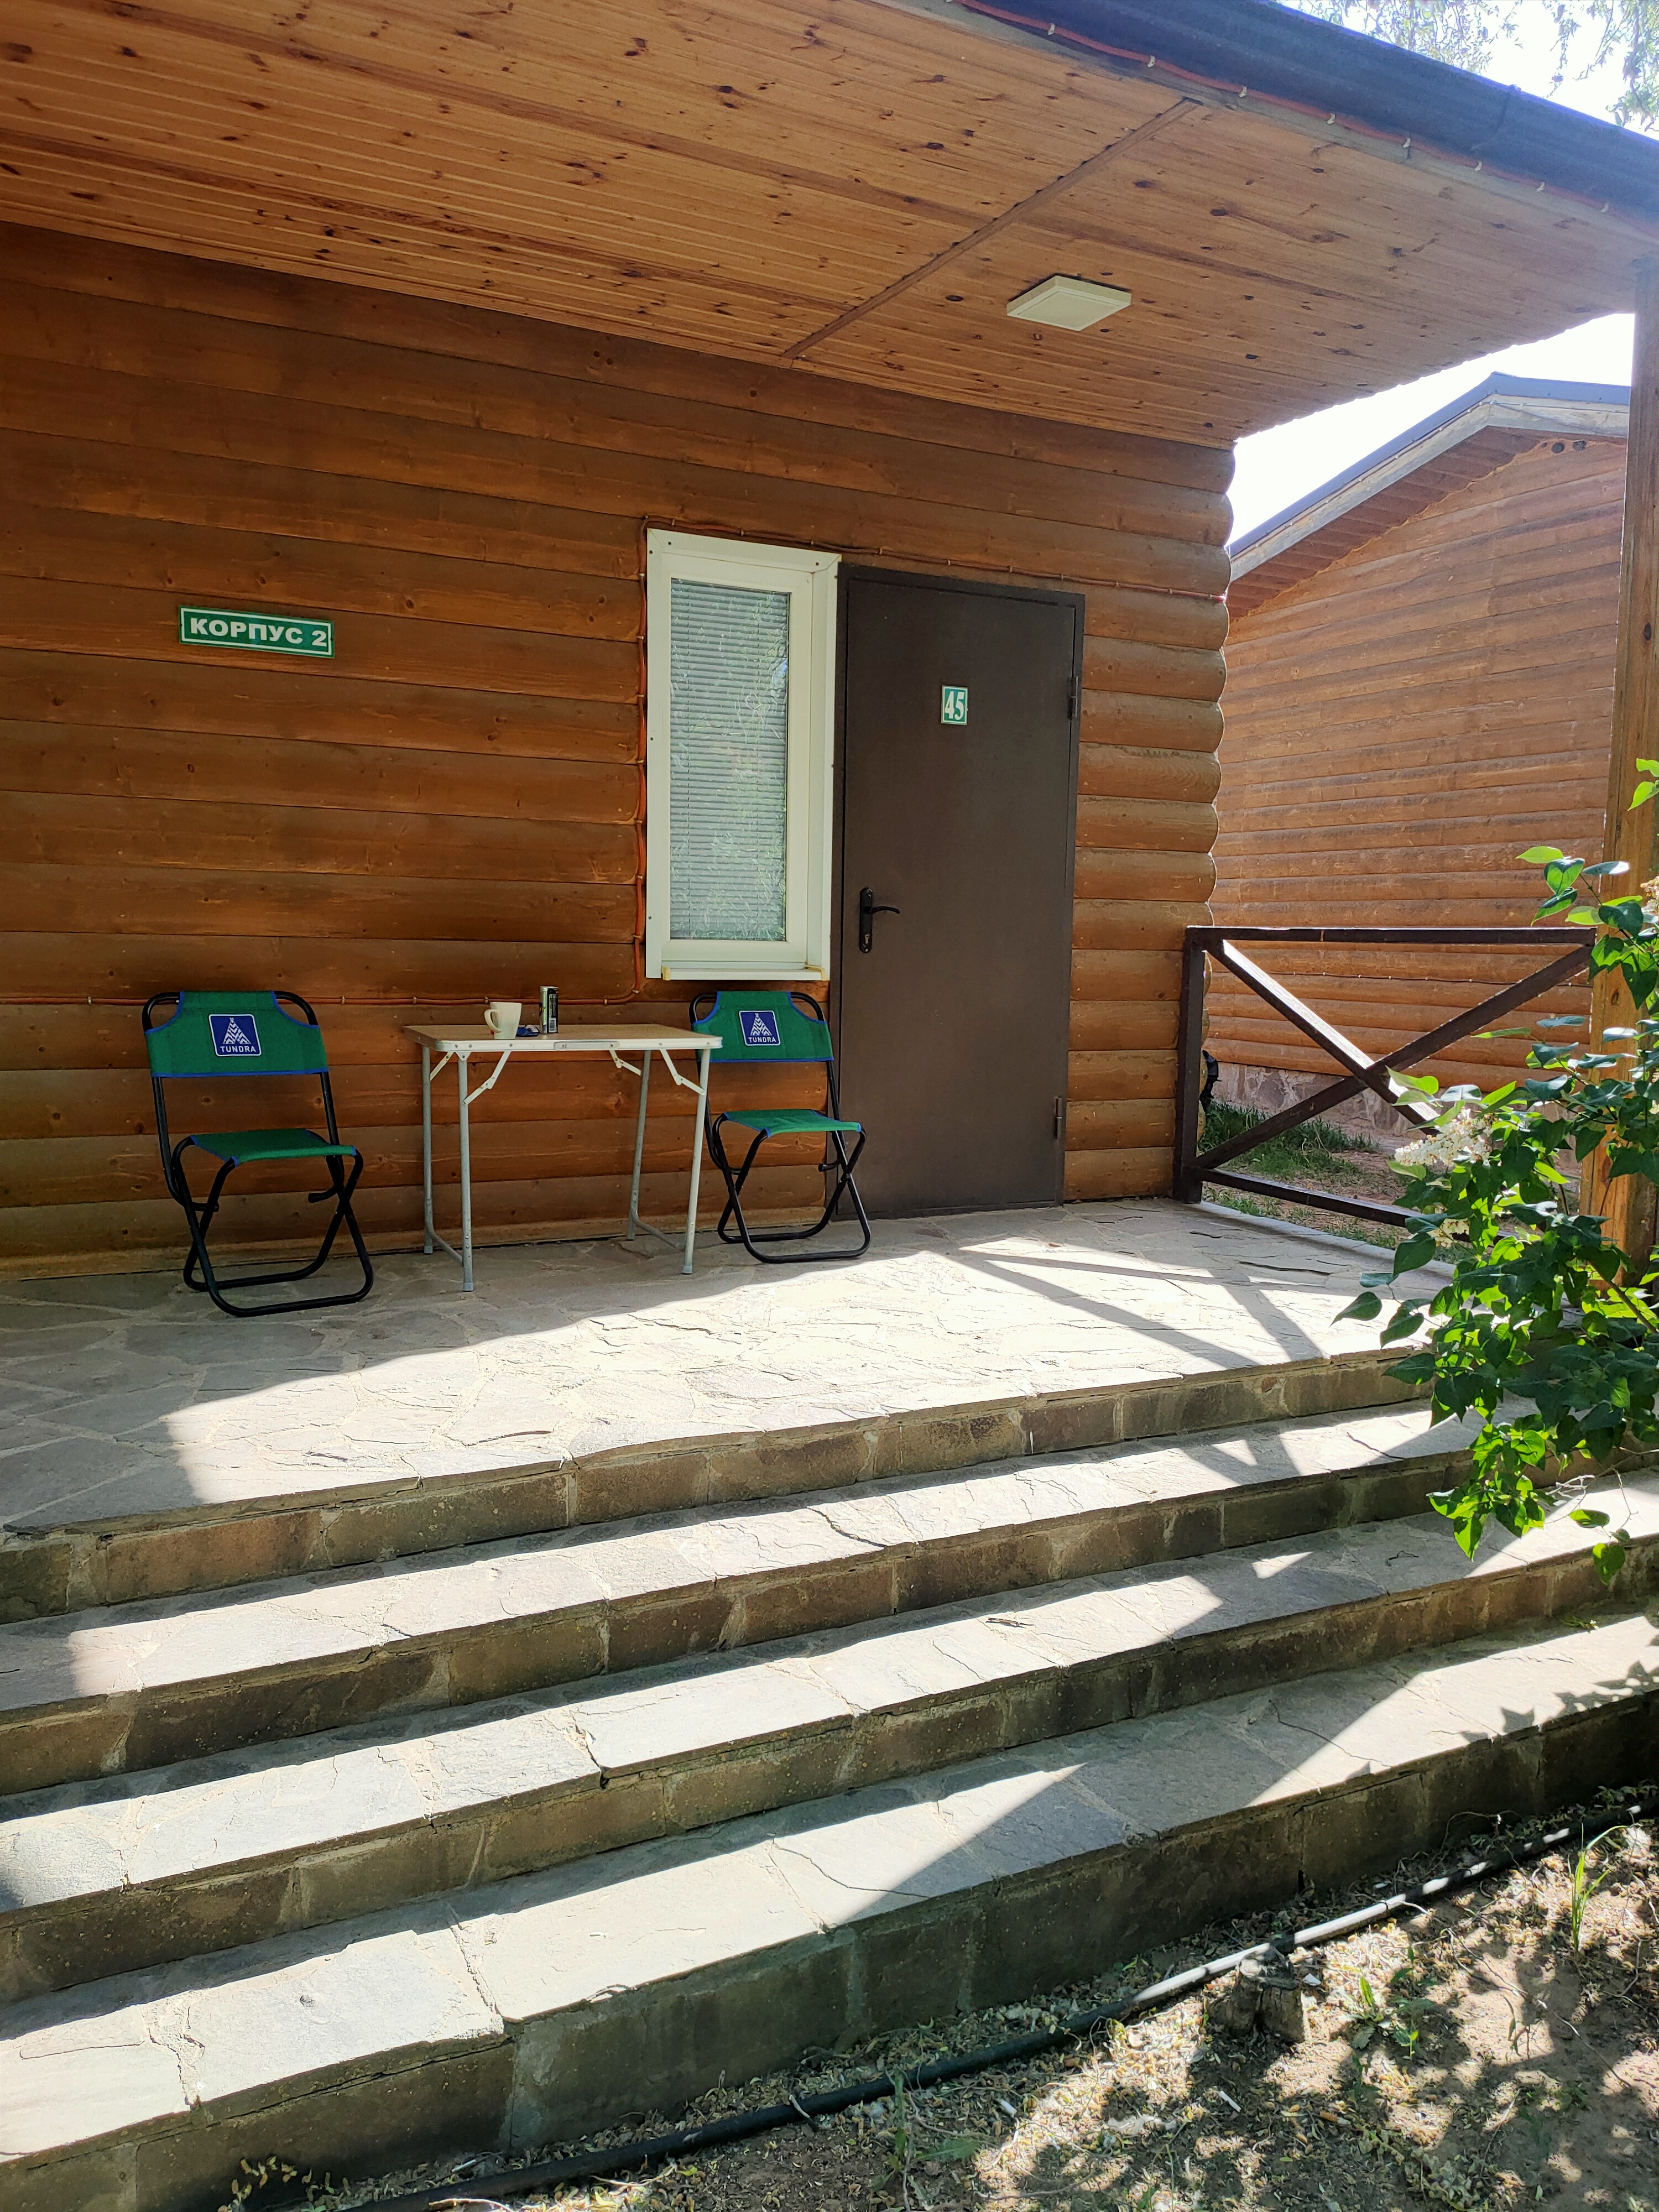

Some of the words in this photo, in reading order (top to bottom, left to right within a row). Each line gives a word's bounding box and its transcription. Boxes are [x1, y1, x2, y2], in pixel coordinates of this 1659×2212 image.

[190, 618, 303, 644] КОРПУС
[311, 630, 327, 647] 2
[945, 691, 965, 721] 45
